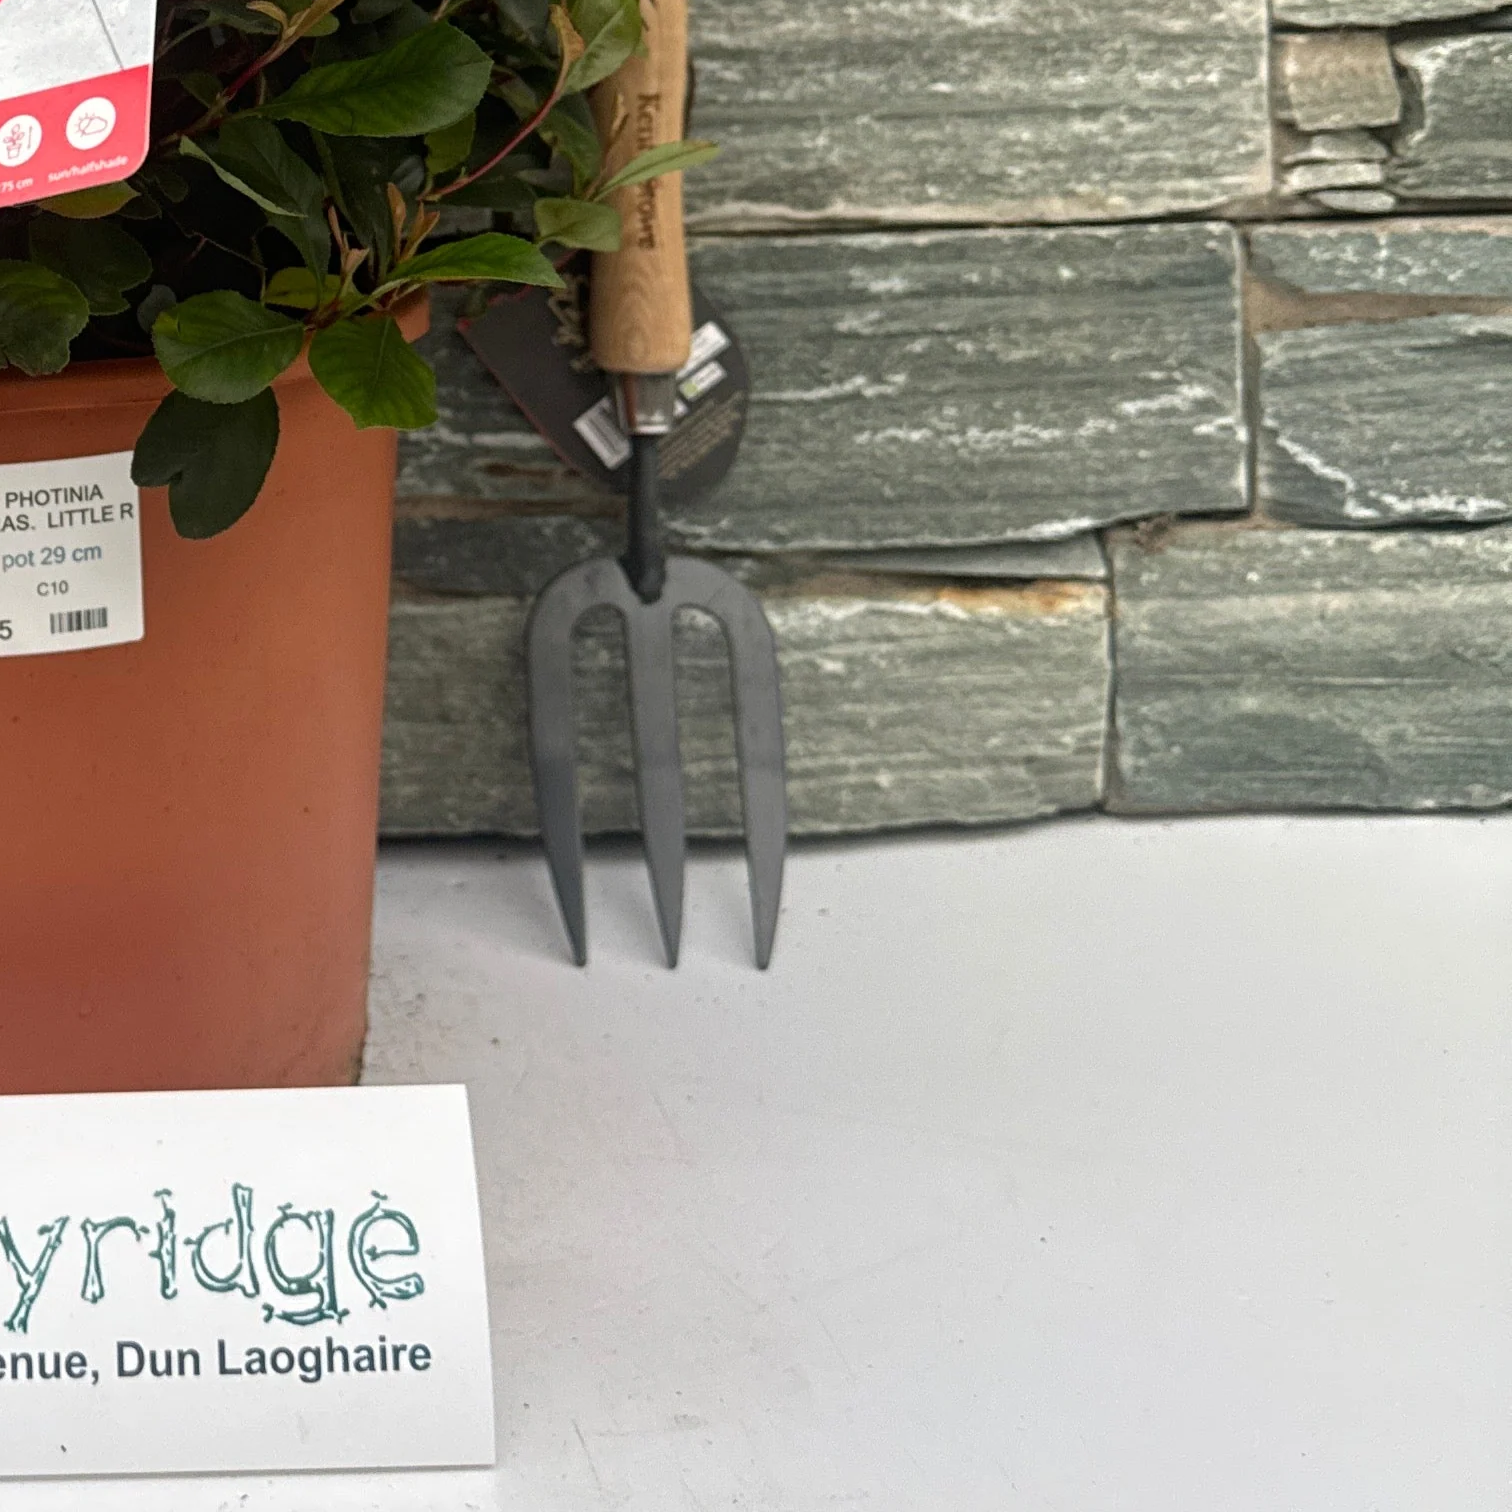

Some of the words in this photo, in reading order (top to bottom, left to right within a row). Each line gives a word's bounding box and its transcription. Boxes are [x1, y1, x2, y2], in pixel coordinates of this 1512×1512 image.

[47, 154, 129, 183] sun/halfshade
[15, 177, 34, 191] cm
[5, 484, 104, 508] PHOTINIA
[47, 504, 114, 529] LITTLE
[120, 502, 134, 520] R
[2, 550, 35, 573] pot
[40, 546, 66, 566] 29
[72, 544, 102, 563] cm
[36, 580, 69, 598] C10
[116, 1340, 201, 1378] Dun
[217, 1335, 432, 1384] Laoghaire
